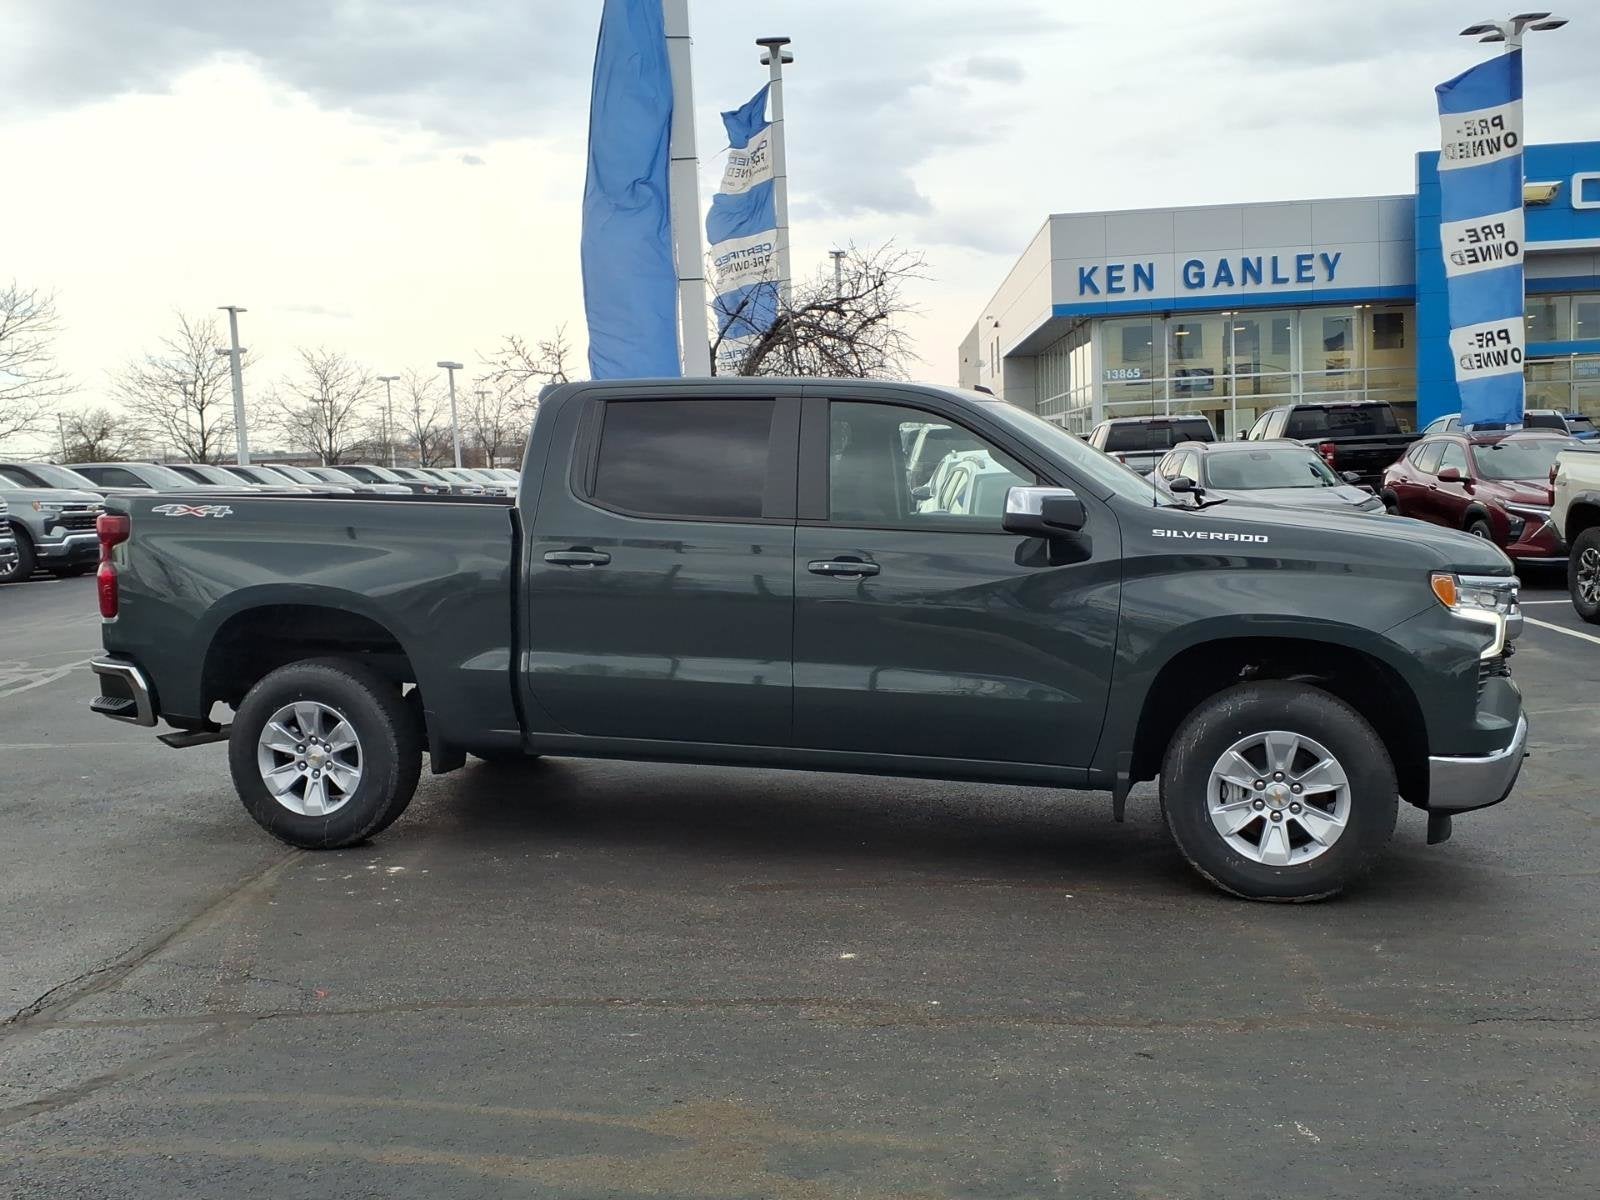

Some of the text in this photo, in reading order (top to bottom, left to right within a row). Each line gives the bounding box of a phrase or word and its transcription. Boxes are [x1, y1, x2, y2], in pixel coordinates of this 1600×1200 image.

[1078, 252, 1343, 296] KEN GANLEY
[1106, 368, 1141, 379] 13865
[1151, 528, 1269, 543] SILVERADO
